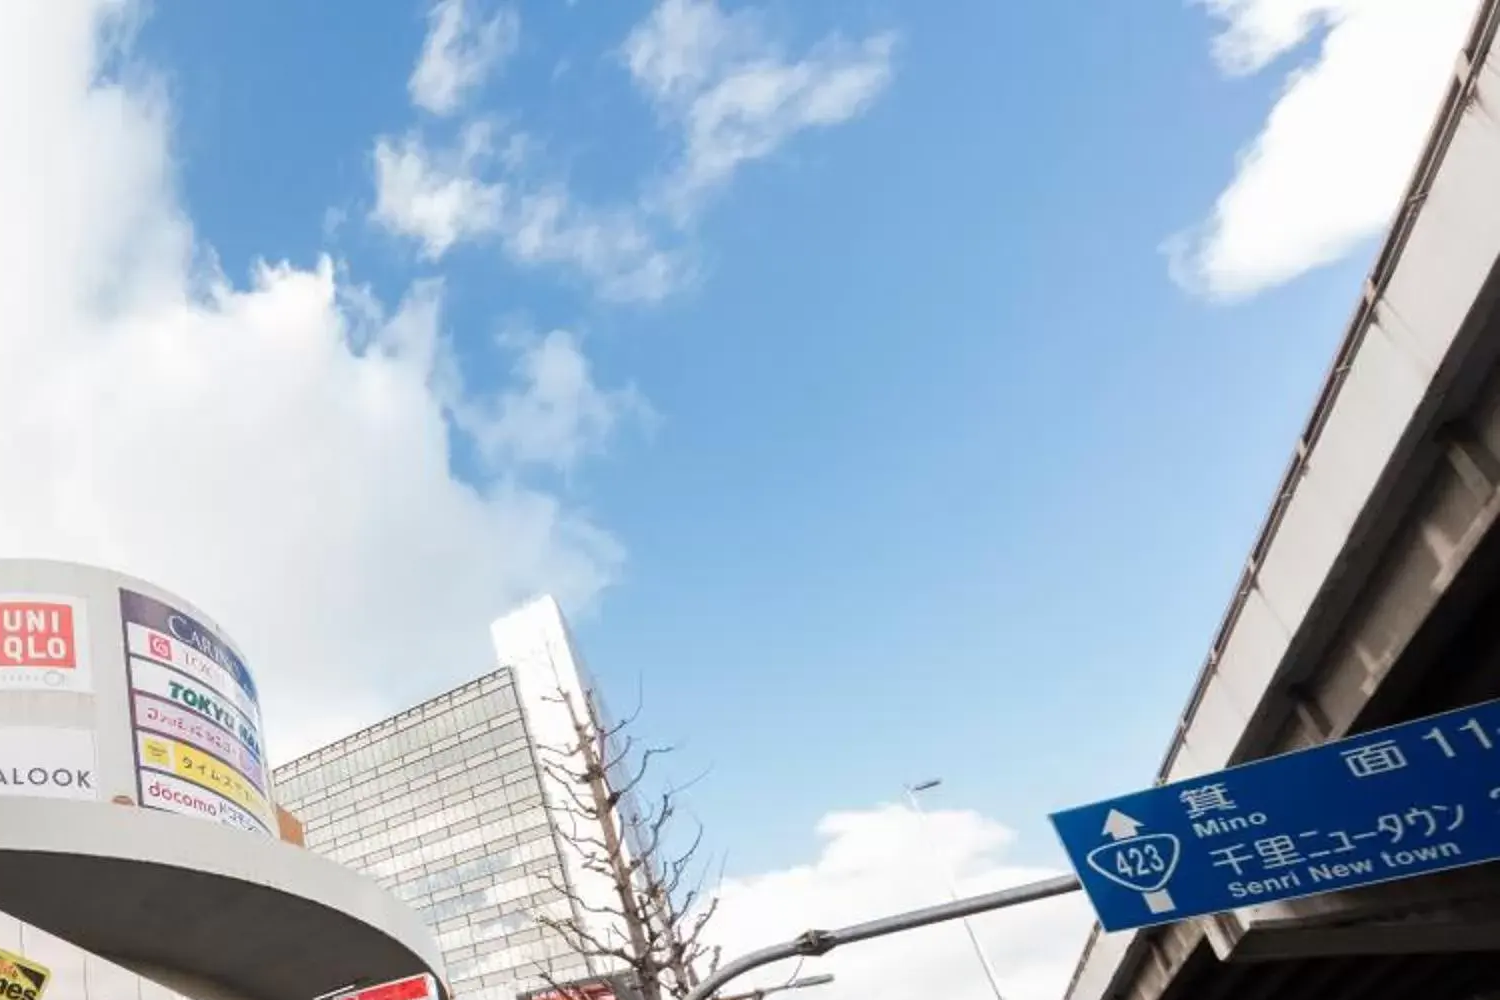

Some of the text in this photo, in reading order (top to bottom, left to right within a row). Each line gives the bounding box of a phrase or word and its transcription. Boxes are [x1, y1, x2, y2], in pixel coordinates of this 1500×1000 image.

[3, 608, 60, 634] UNI
[3, 635, 67, 663] QLO
[168, 680, 235, 730] TOKYU
[149, 782, 217, 817] docomo
[1193, 811, 1267, 838] Mino
[1209, 804, 1464, 876] 千里ニュータウン
[1116, 844, 1164, 878] 423
[1228, 842, 1462, 898] Senri New town
